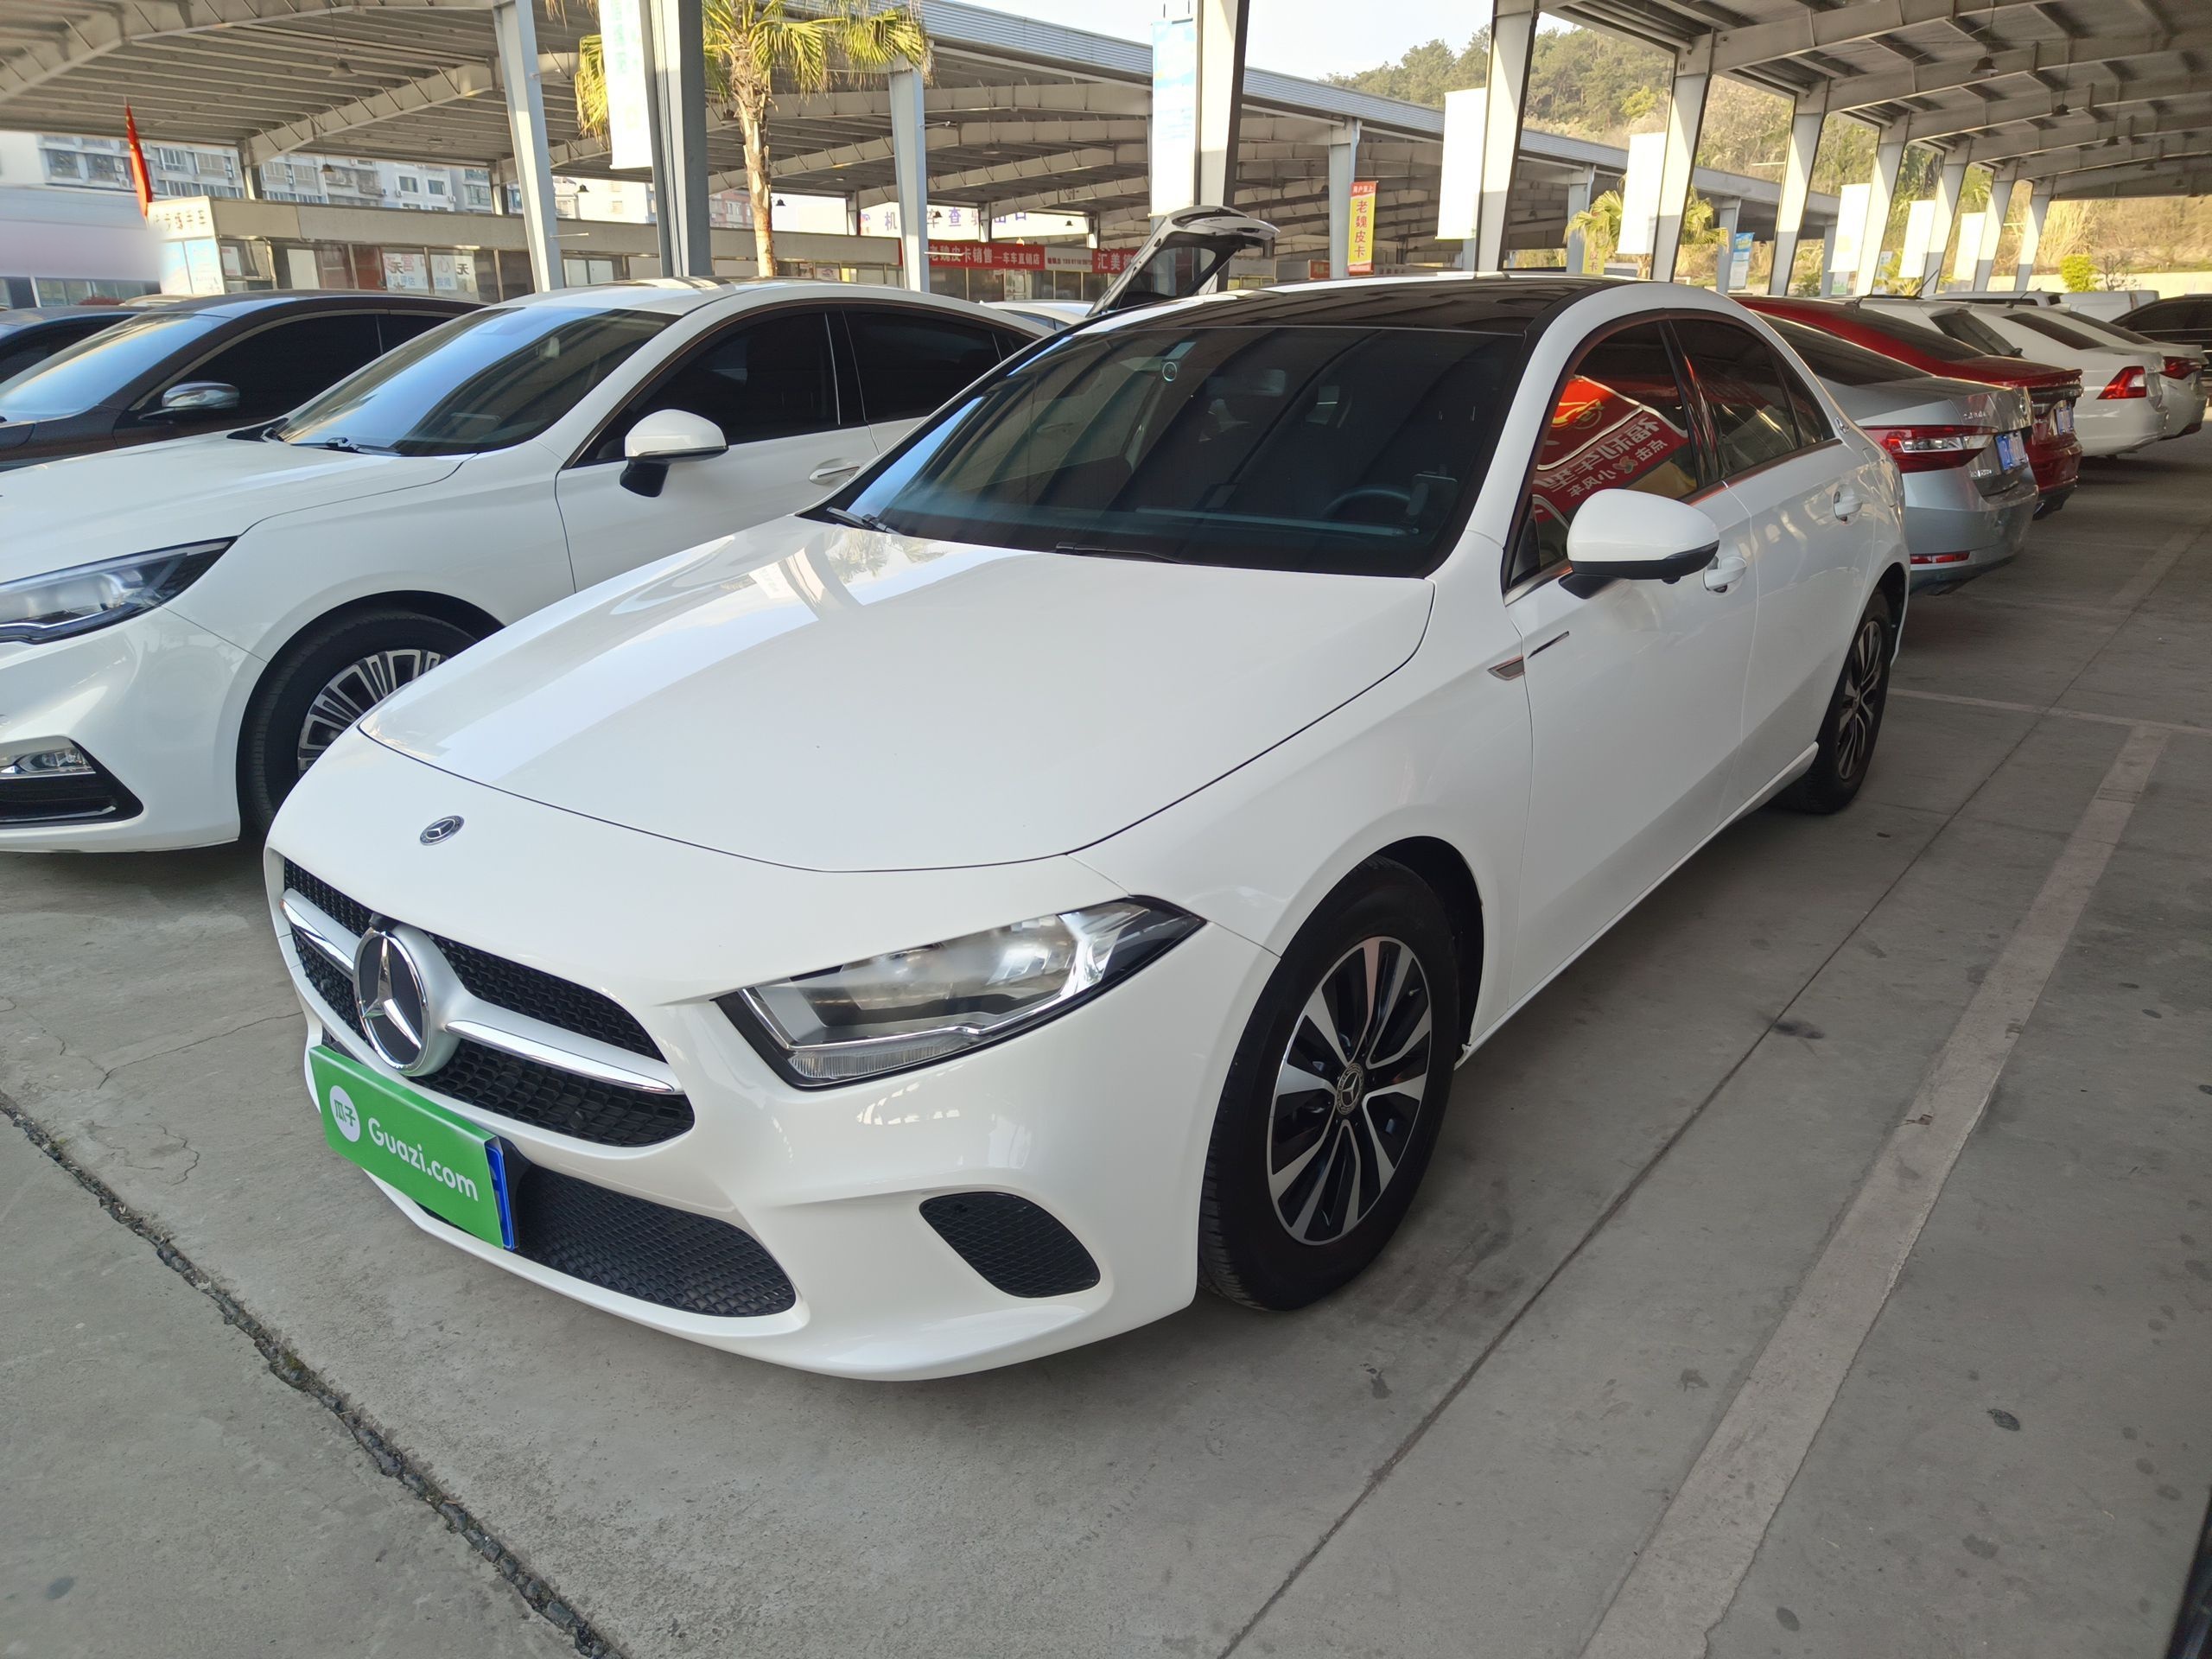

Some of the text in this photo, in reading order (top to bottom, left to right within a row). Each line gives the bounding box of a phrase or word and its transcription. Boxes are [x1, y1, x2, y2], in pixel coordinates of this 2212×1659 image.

[1354, 200, 1369, 260] 老魏皮卡
[334, 1098, 356, 1127] 瓜子
[367, 1116, 479, 1202] Guazi.com
